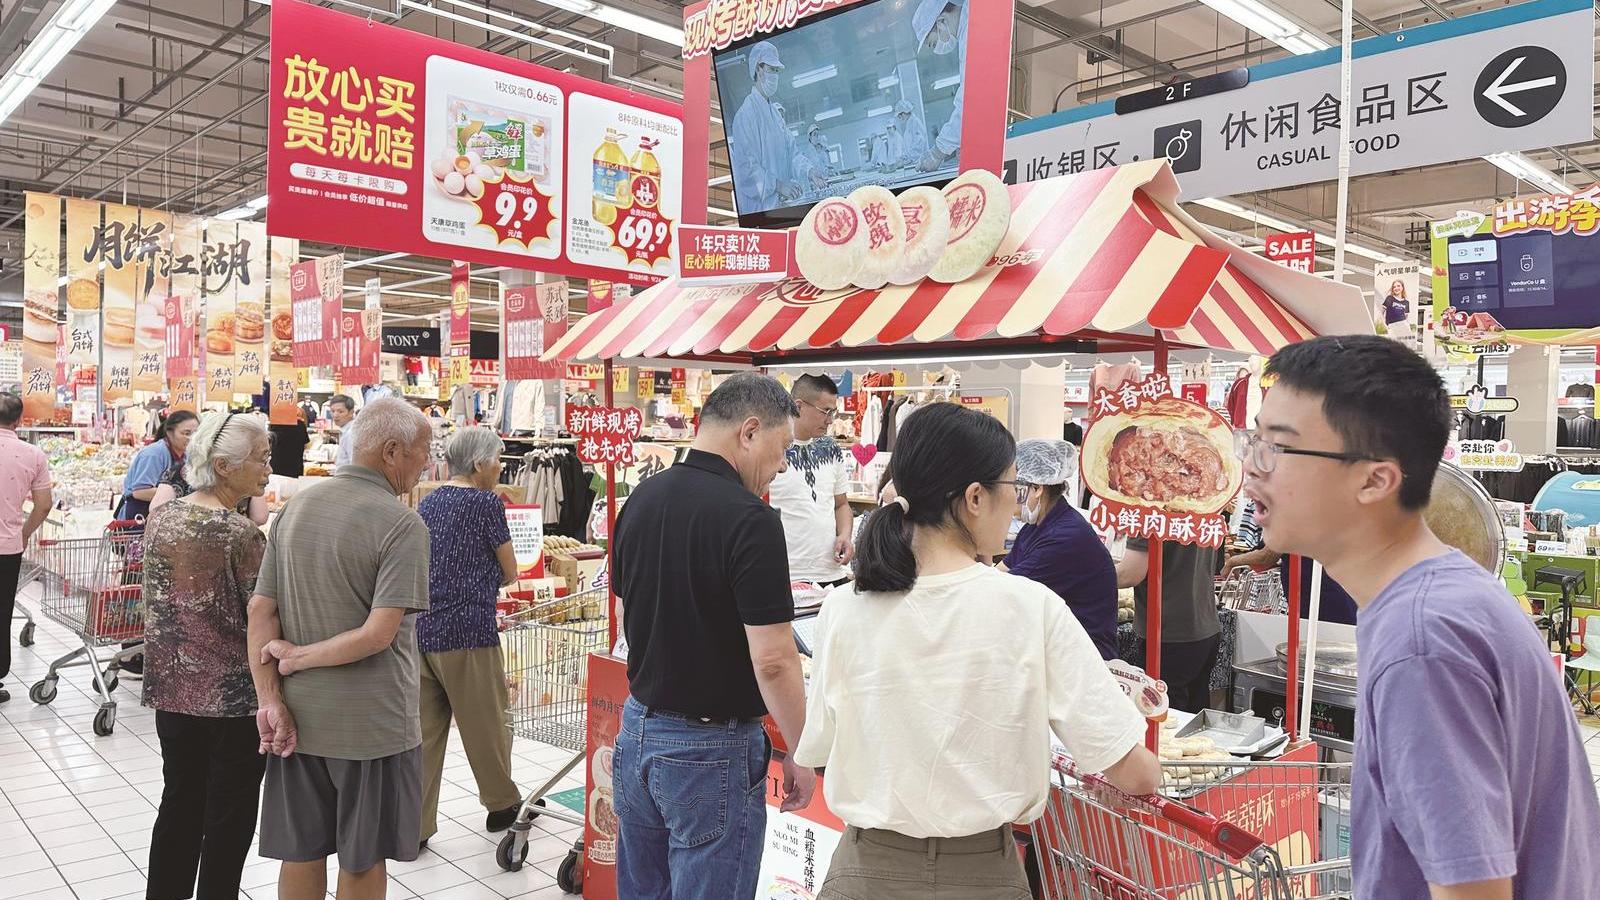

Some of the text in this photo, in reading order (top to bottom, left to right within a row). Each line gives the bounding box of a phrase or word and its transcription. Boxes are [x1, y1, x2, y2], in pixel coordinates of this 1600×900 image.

[284, 53, 416, 122] 放心买
[494, 81, 558, 105] 1枚仅需0.66元
[1220, 71, 1448, 150] 休闲食品区
[282, 106, 415, 170] 贵就赔
[483, 145, 521, 159] 草鸡蛋
[1257, 145, 1331, 170] CASUAL
[1026, 141, 1120, 182] 收银区
[305, 167, 394, 191] 每天每卡限购
[501, 183, 532, 195] 会员印花价
[349, 193, 385, 206] 低价超值
[495, 192, 537, 229] 9.9
[1496, 186, 1600, 232] 出游季
[507, 229, 522, 239] 元/盒
[618, 216, 667, 252] 69.9
[694, 234, 760, 253] 1年只卖1次
[1269, 238, 1312, 256] SALE
[83, 221, 252, 300] 月饼江湖
[684, 254, 770, 270] 匠心制作现制鲜酥
[1377, 266, 1419, 276] 人气明星单品
[72, 329, 92, 341] 台式
[387, 335, 419, 346] TONY
[70, 340, 94, 354] 月饼
[28, 367, 52, 384] 苏式
[111, 367, 129, 378] 新疆
[138, 361, 161, 376] 月饼
[239, 364, 260, 376] 月饼
[27, 382, 51, 395] 月饼
[108, 377, 130, 391] 月饼
[211, 379, 231, 392] 月饼
[175, 393, 194, 406] 月饼
[1094, 373, 1171, 418] 太香啦
[569, 409, 640, 434] 新鲜现烤
[581, 437, 633, 461] 抢先吃
[1093, 505, 1226, 546] 小鲜肉酥饼
[786, 823, 798, 833] XUE
[773, 829, 798, 845] NUO MI
[772, 842, 798, 857] SU BING
[804, 828, 816, 892] 血糯米酥饼
